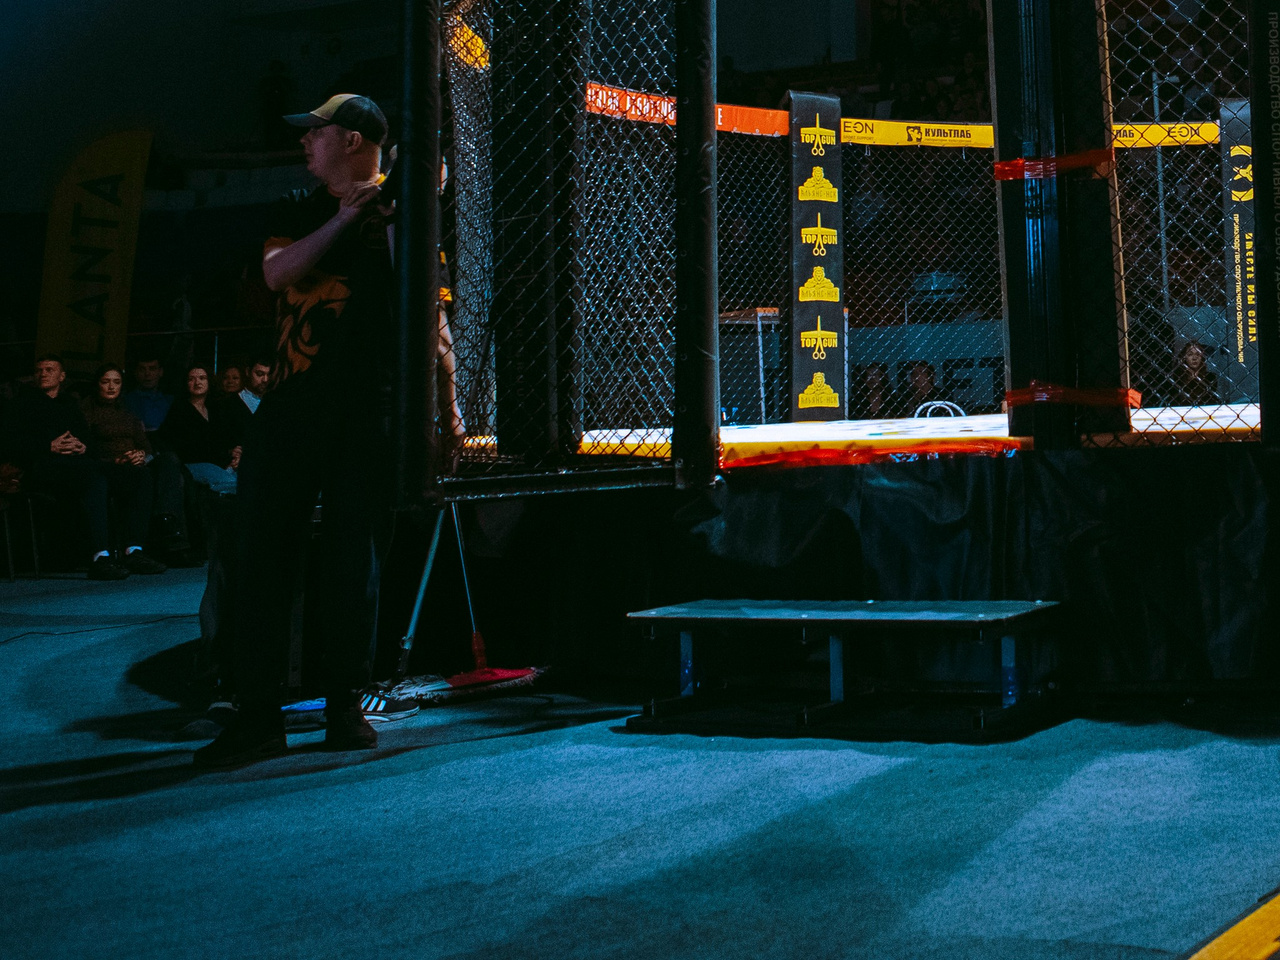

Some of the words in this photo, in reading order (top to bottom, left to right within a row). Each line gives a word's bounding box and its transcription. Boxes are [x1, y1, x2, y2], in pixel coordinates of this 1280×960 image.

[800, 133, 815, 143] TOP
[821, 135, 836, 145] GUN
[924, 127, 972, 139] КУЛЬТЛАБ
[801, 234, 817, 244] TOP
[822, 235, 838, 245] GUN
[1244, 232, 1255, 279] ВМЕСТЕ
[1247, 284, 1256, 305] МЫ
[1248, 309, 1257, 343] СИЛА
[801, 338, 816, 348] TOP
[823, 338, 838, 348] GUN
